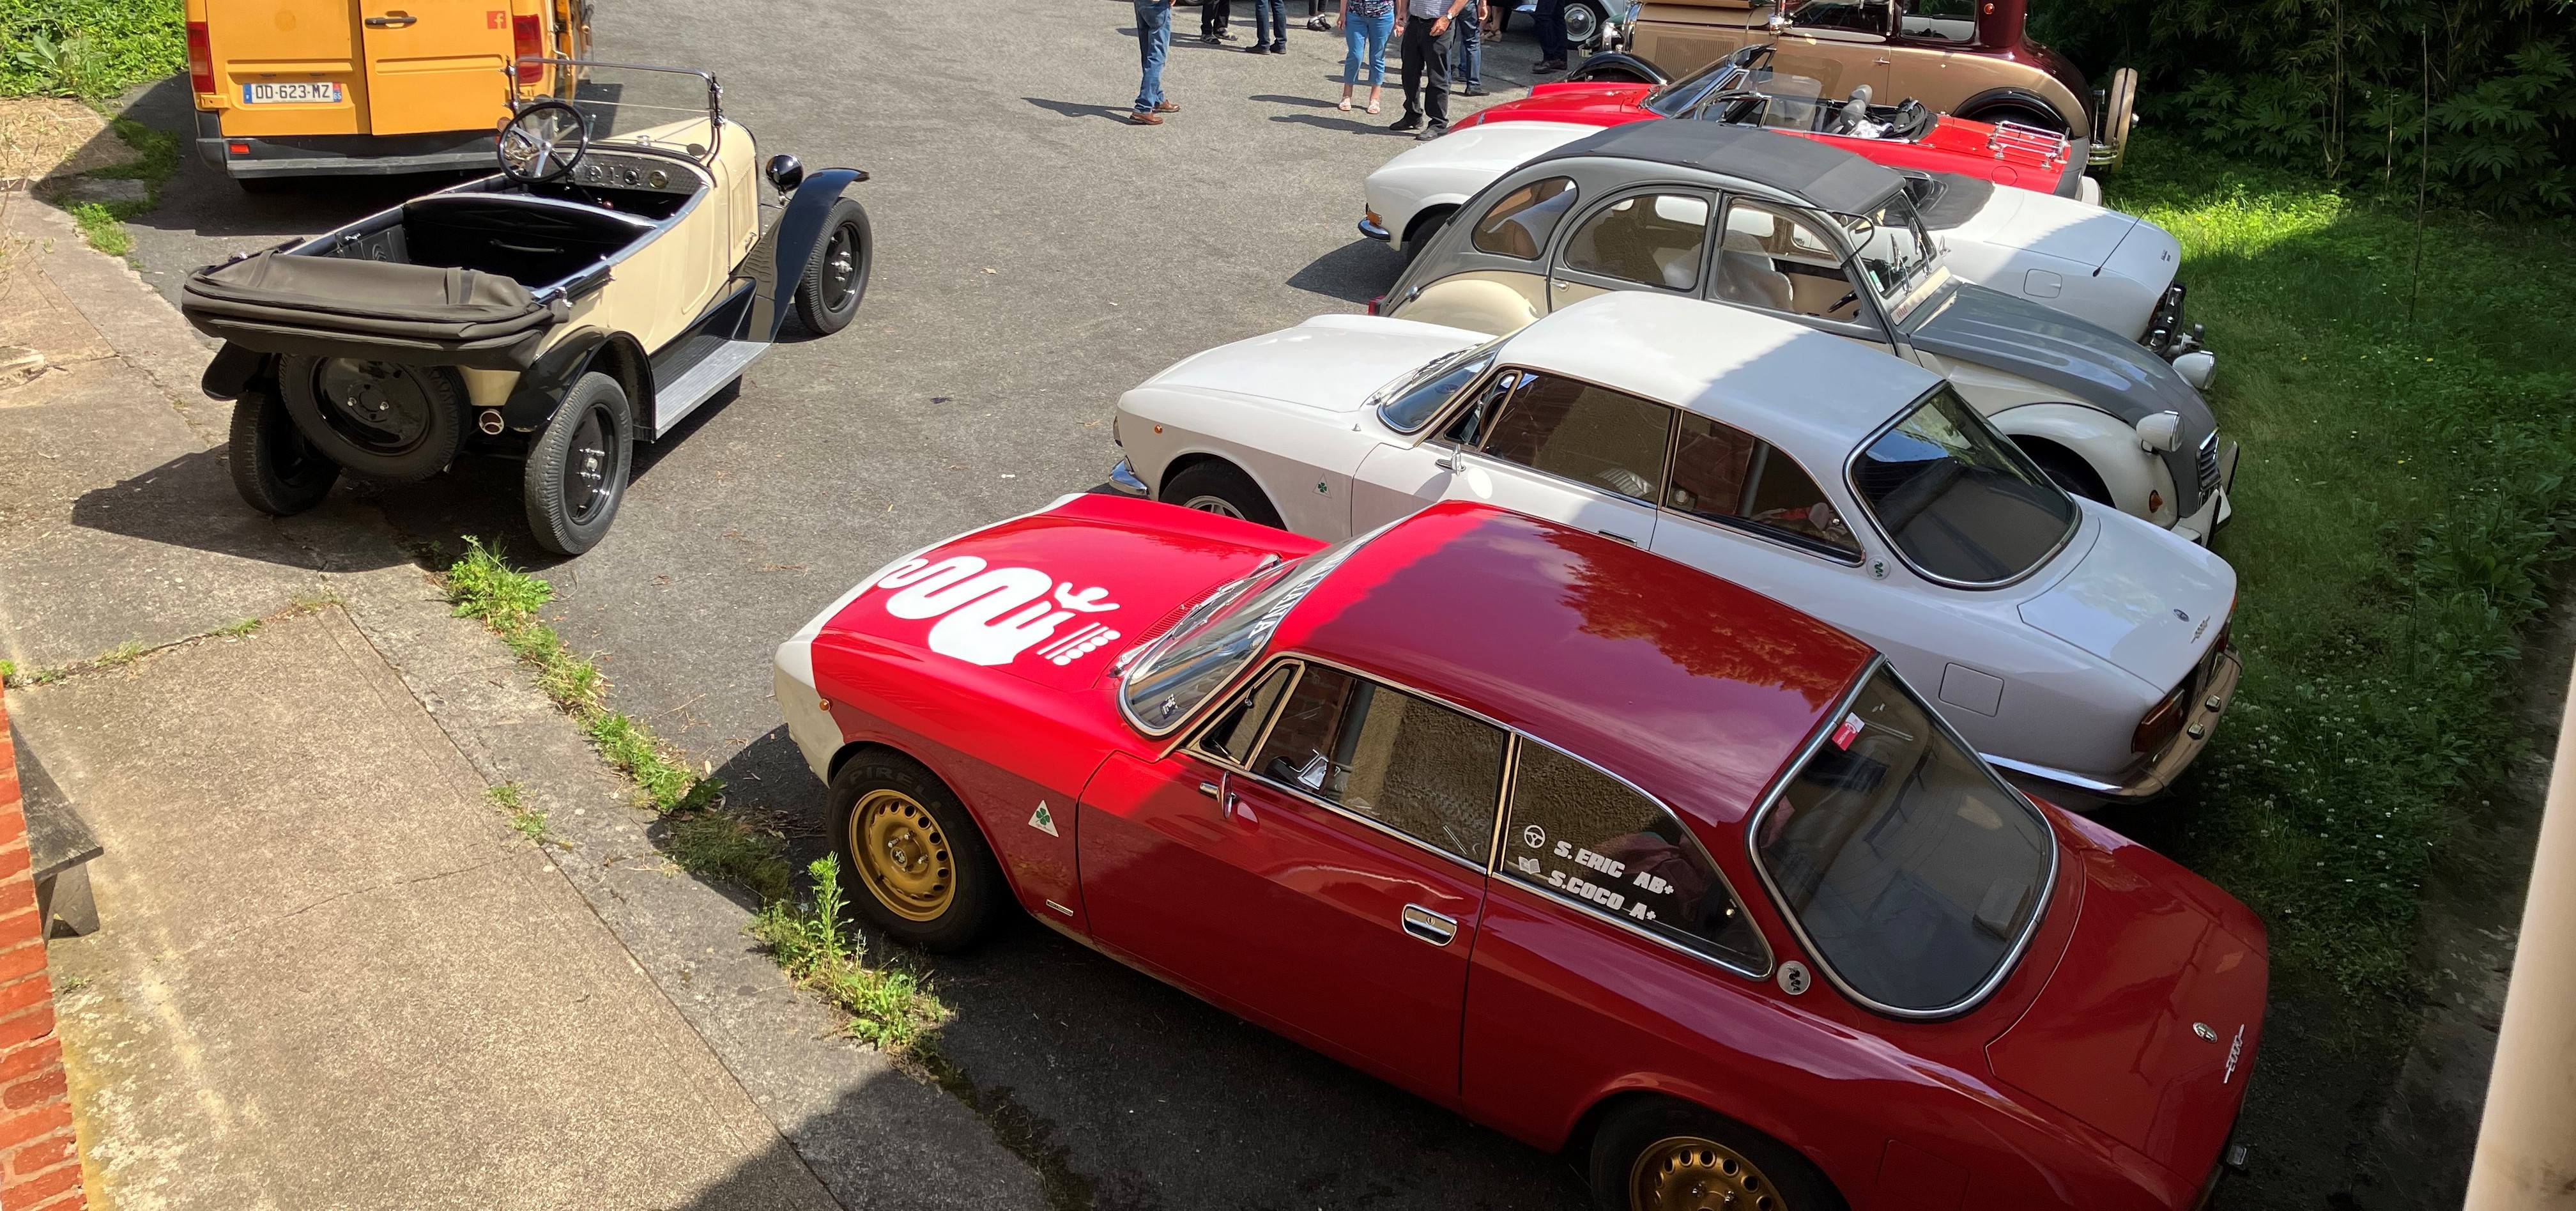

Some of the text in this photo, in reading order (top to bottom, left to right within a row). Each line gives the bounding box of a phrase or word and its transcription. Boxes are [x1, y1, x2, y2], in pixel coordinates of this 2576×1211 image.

[1574, 847, 1625, 878] ERIC
[1632, 871, 1674, 895] AB+
[1629, 902, 1657, 920] A+
